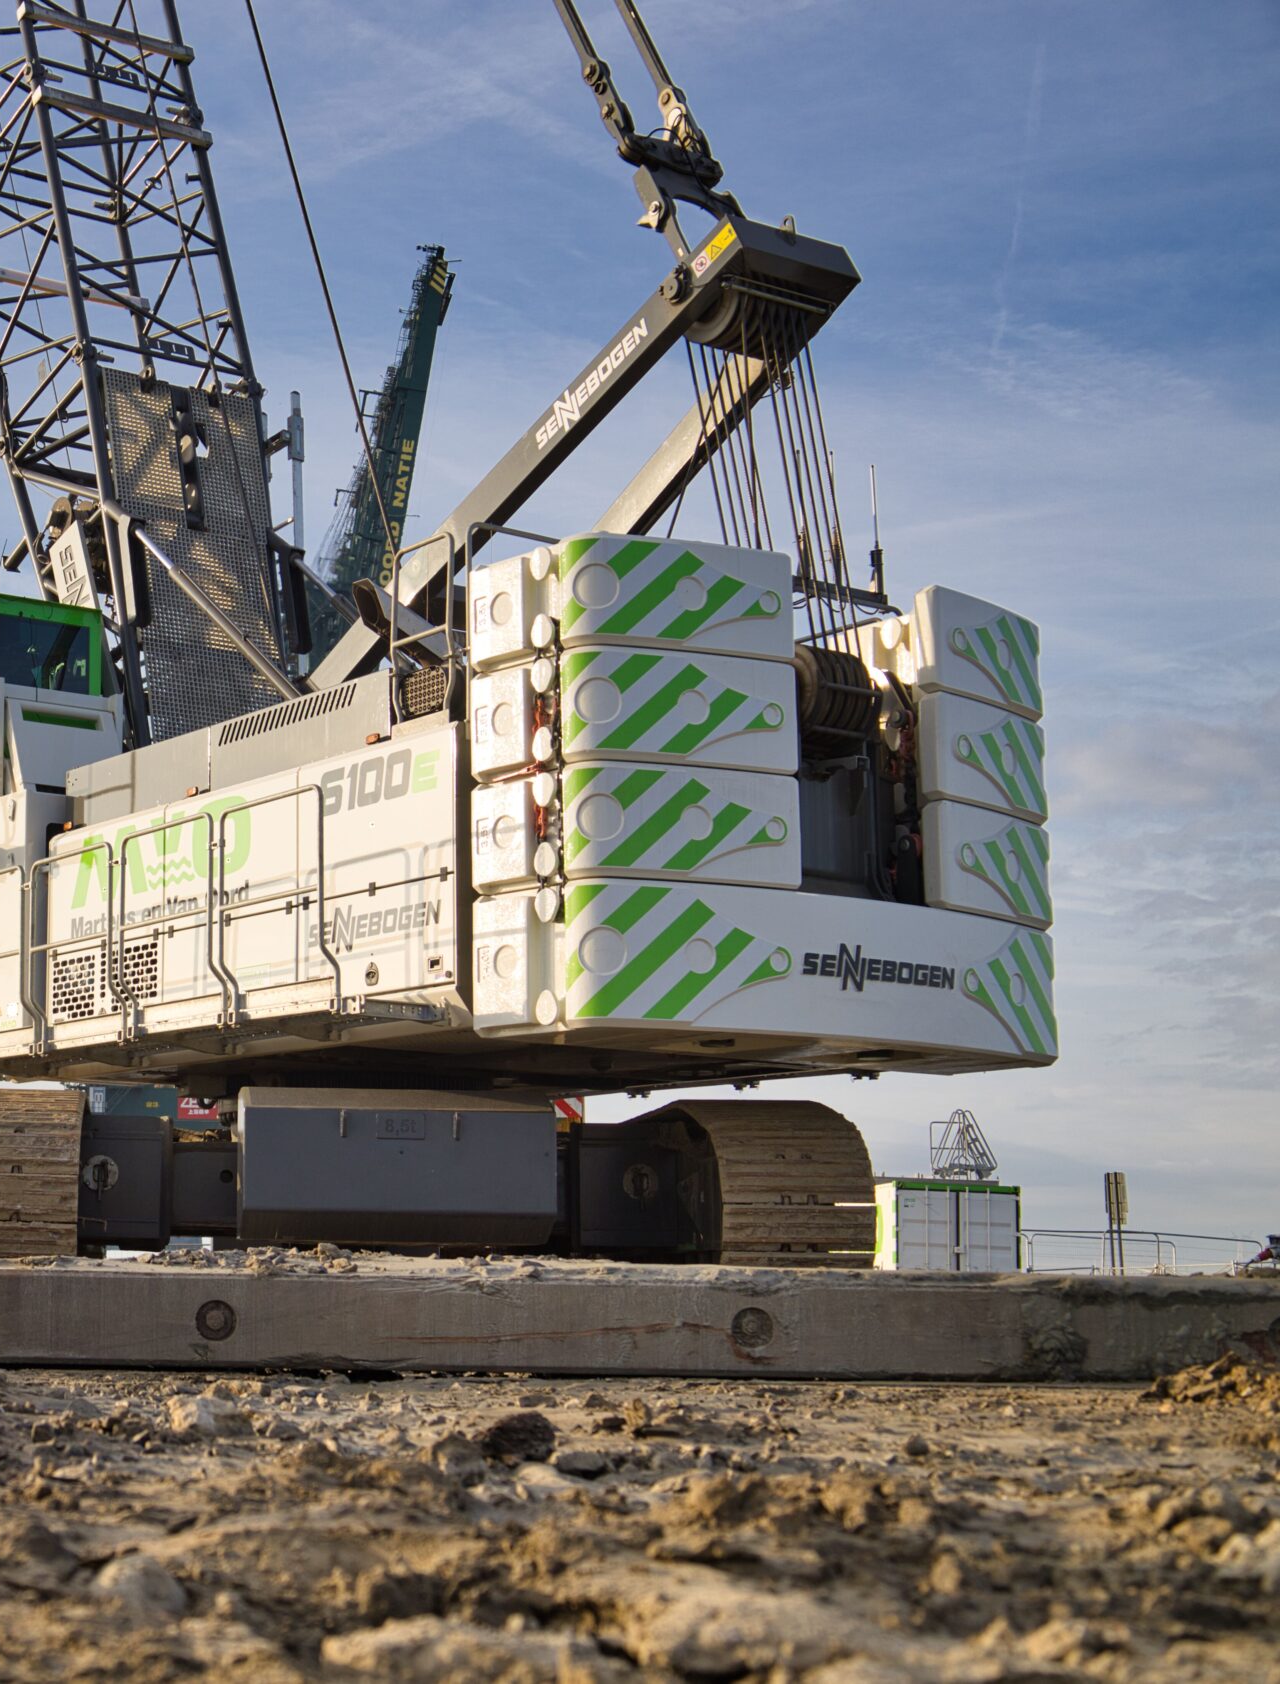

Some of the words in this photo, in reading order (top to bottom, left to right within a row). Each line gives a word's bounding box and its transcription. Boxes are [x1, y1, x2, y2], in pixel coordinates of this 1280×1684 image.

[535, 318, 648, 450] SENNEBOGEN
[392, 438, 415, 508] NATIE
[141, 902, 162, 920] en
[167, 895, 199, 915] Van
[308, 900, 441, 955] SENNEBOGEN
[802, 943, 956, 993] SENNEBOGEN
[385, 1118, 417, 1137] 8,5t
